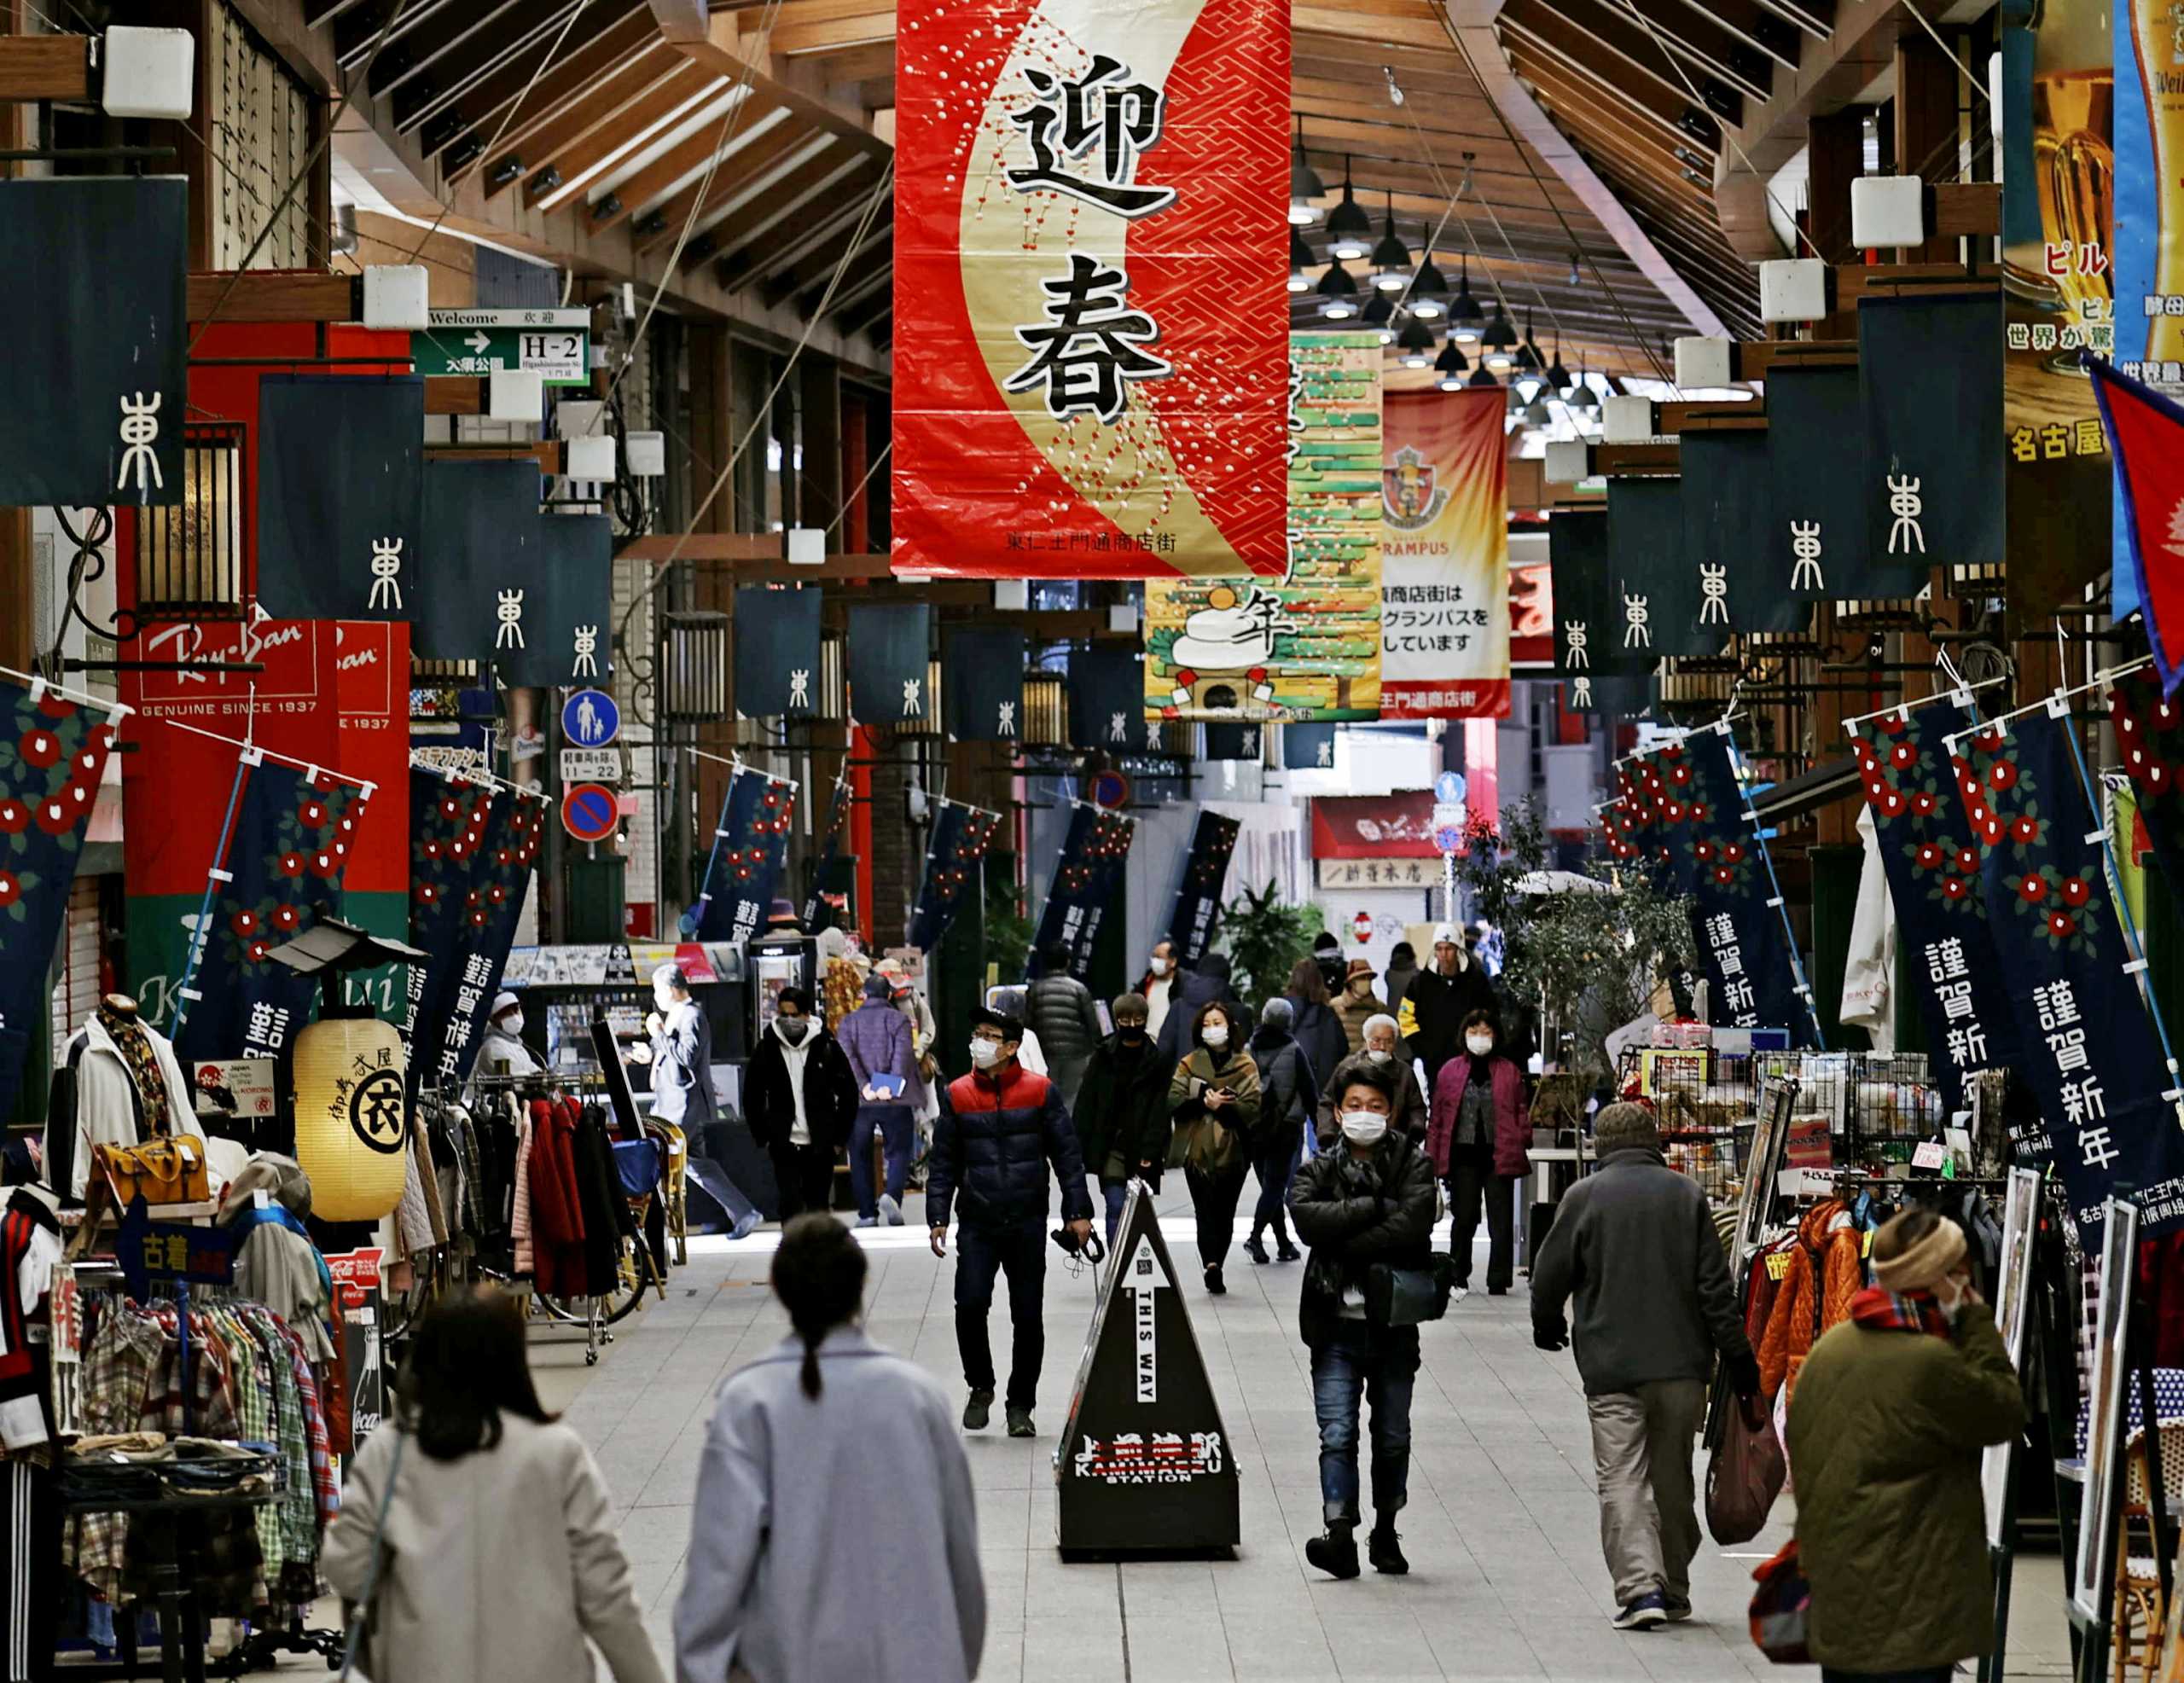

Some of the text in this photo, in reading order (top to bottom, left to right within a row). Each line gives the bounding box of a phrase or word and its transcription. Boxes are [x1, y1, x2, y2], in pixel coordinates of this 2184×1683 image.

[1003, 55, 1178, 423] 迎春
[2046, 241, 2106, 276] ピル
[429, 312, 498, 325] Welcome
[525, 335, 578, 358] H-2
[2123, 361, 2184, 383] 世界最
[2011, 418, 2105, 461] 名古屋
[1382, 543, 1449, 555] RAMPUS
[1384, 634, 1471, 653] しています
[142, 701, 317, 717] GENUINE SINCE 1937
[354, 718, 391, 729] 1937
[2032, 978, 2121, 1171] 謹賀新年
[363, 1082, 402, 1135] 衣
[142, 1232, 189, 1272] 古着
[1139, 1291, 1153, 1398] THIS WAY
[1075, 1460, 1222, 1477] KAMIMAEZU
[1106, 1475, 1193, 1484] STATION
